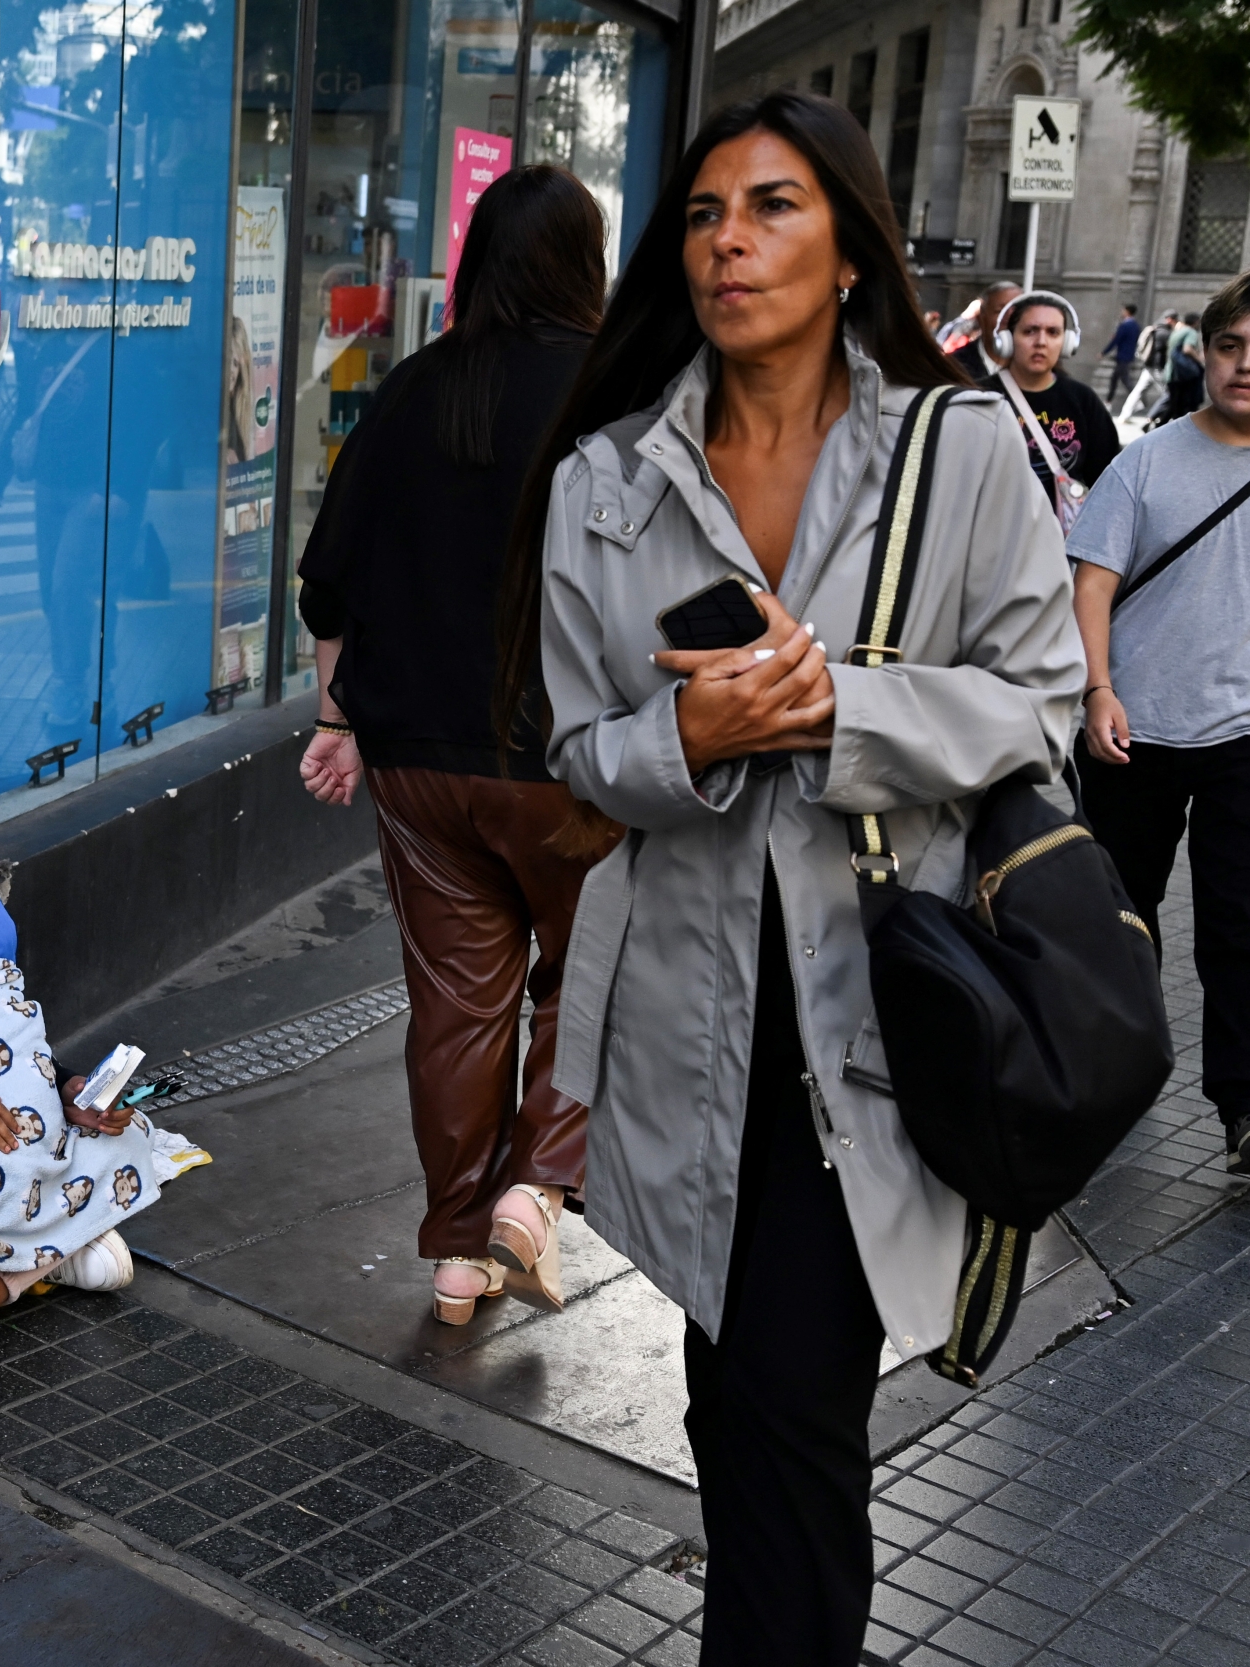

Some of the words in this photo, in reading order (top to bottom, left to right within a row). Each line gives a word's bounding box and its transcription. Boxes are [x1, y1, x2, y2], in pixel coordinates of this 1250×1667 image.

[1023, 158, 1064, 173] CONTROL
[18, 295, 82, 329] Mucho
[86, 296, 119, 329] más
[119, 303, 149, 337] que
[151, 296, 192, 328] salud
